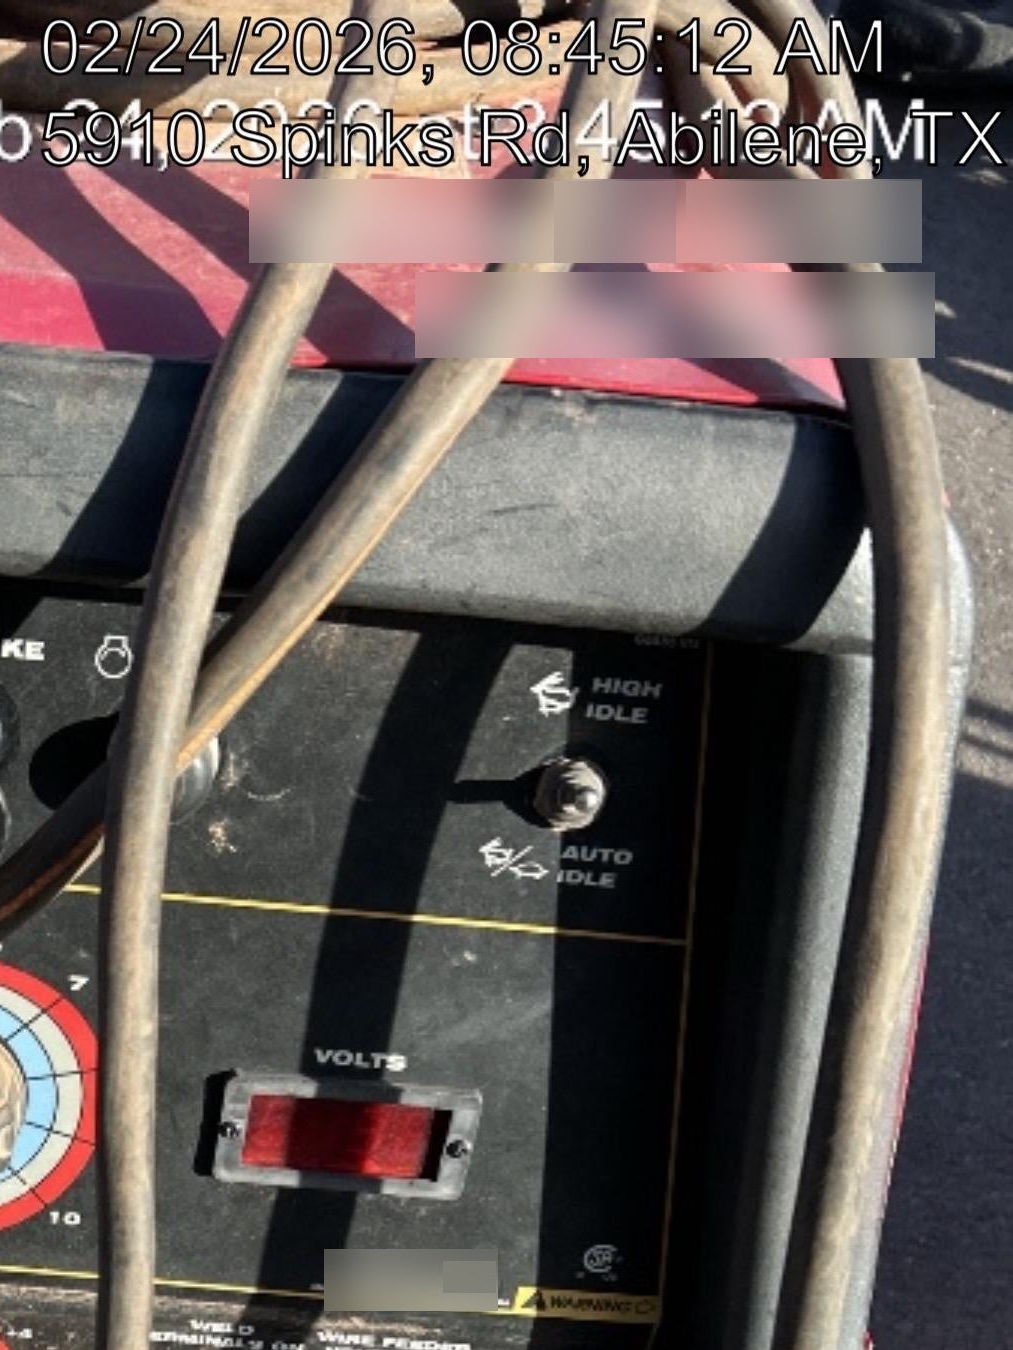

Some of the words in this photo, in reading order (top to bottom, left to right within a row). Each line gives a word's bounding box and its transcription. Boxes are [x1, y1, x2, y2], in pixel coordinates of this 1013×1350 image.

[592, 677, 663, 699] HIGH
[585, 703, 649, 724] IDLE
[561, 845, 634, 866] AUTO
[555, 869, 617, 889] IDLE
[67, 974, 90, 993] 7
[313, 1047, 409, 1072] VOLTS
[48, 1210, 82, 1226] 10
[549, 1294, 634, 1314] WARNING
[316, 1330, 376, 1345] WIRE
